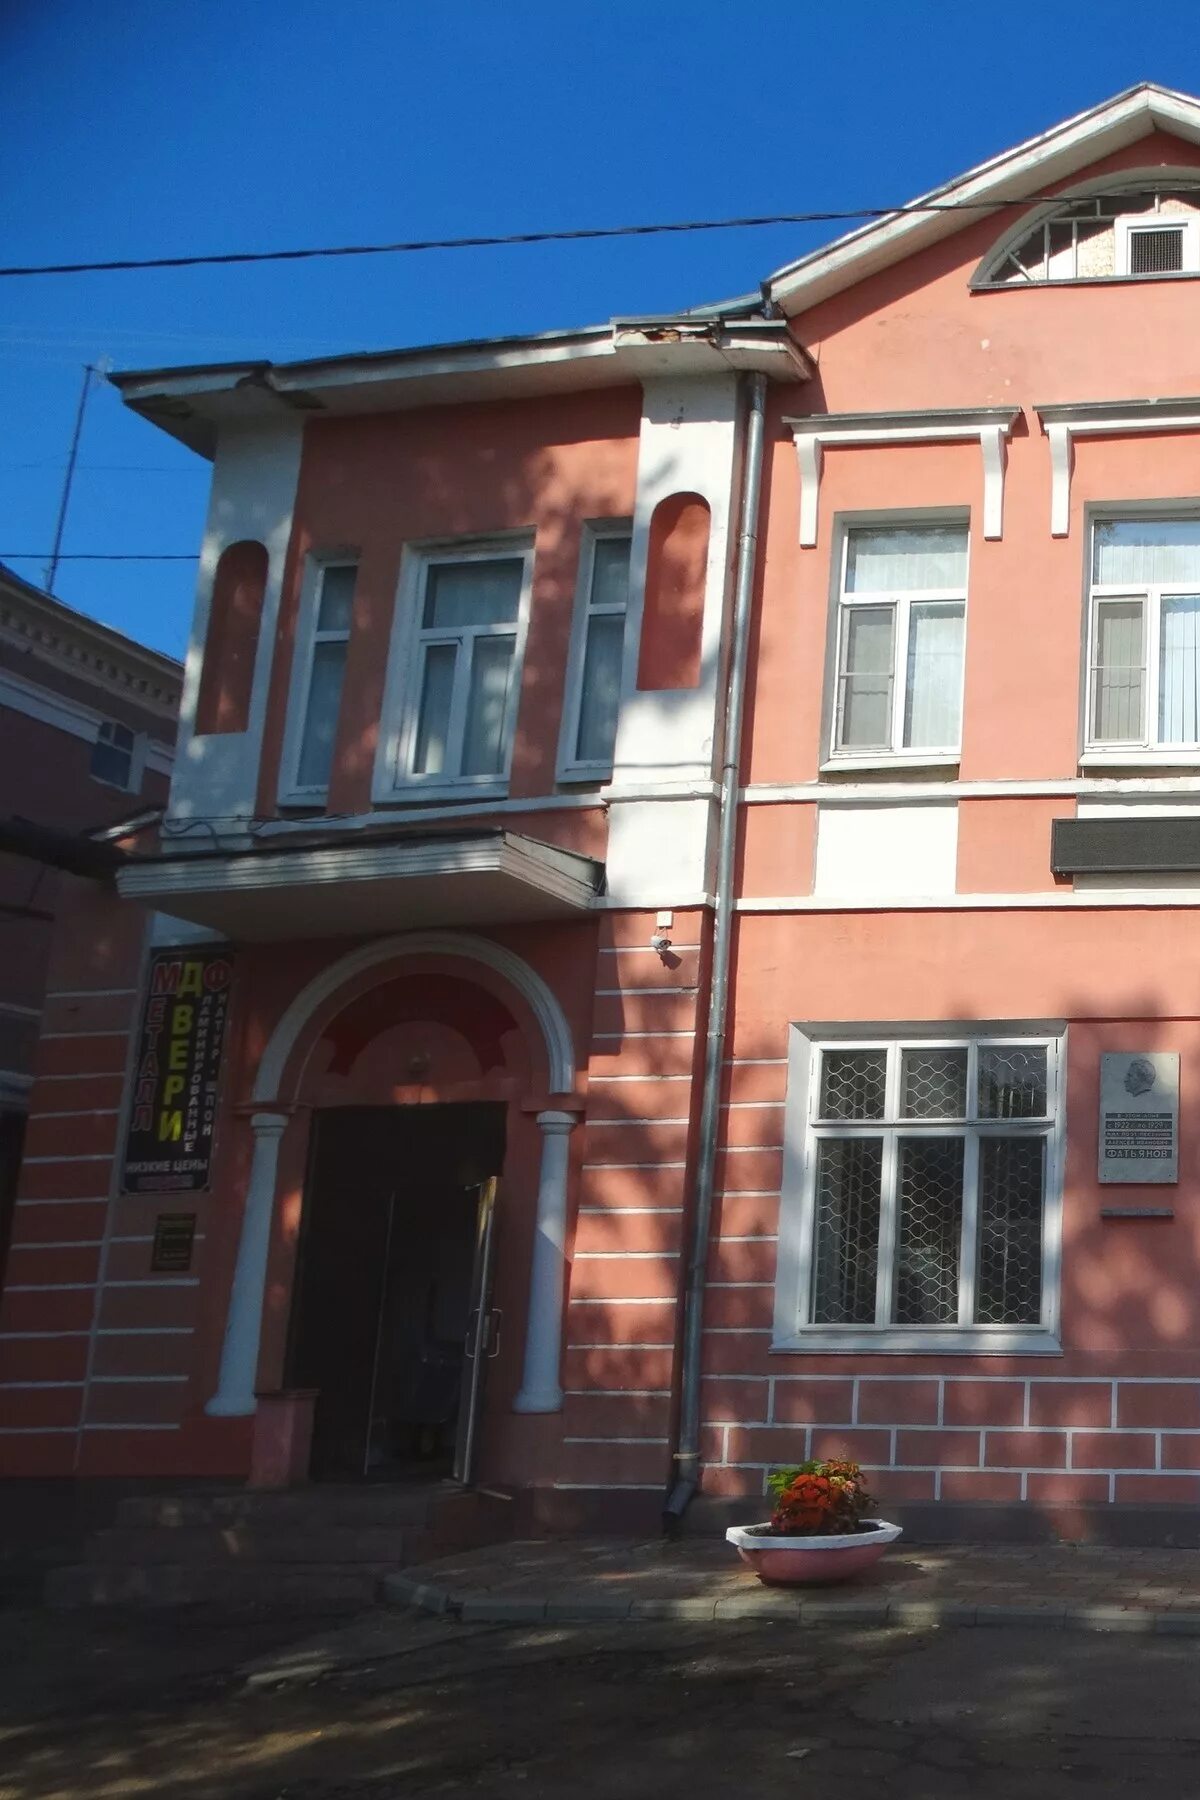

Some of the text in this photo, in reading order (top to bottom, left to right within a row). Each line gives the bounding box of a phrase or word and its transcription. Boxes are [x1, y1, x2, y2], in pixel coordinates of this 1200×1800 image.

[158, 962, 204, 1141] ДВЕРИ
[184, 995, 212, 1152] ЛАМИНИРОВАННЫЕ
[202, 1081, 217, 1136] ШПОН
[126, 1159, 208, 1173] НИЗКИЕ ЦЕНЫ
[1107, 1149, 1168, 1158] ФАТЬЯНОВ
